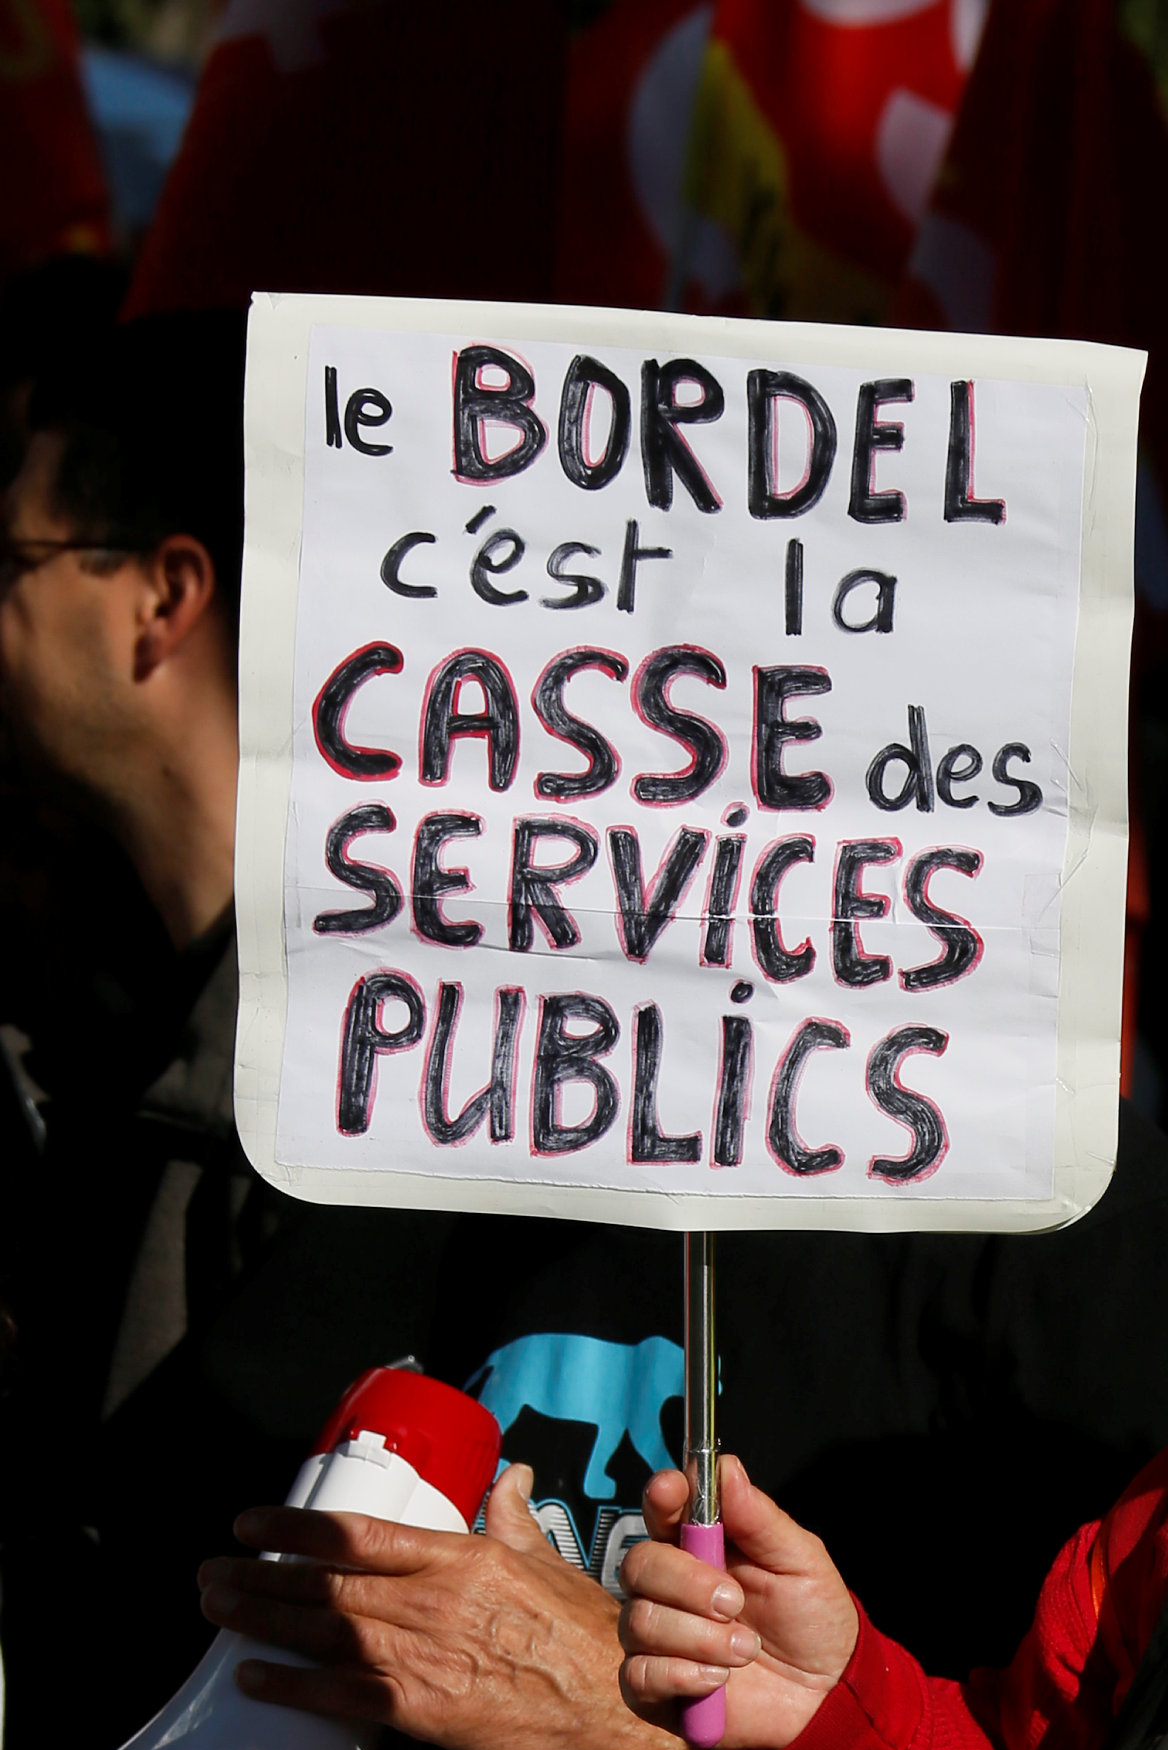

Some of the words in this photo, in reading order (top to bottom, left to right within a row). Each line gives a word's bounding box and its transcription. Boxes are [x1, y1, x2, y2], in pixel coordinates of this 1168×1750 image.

[324, 365, 394, 456] le
[450, 343, 1007, 525] BORDEL
[784, 538, 898, 636] la
[311, 640, 833, 812] CASSE
[865, 705, 1044, 817] des
